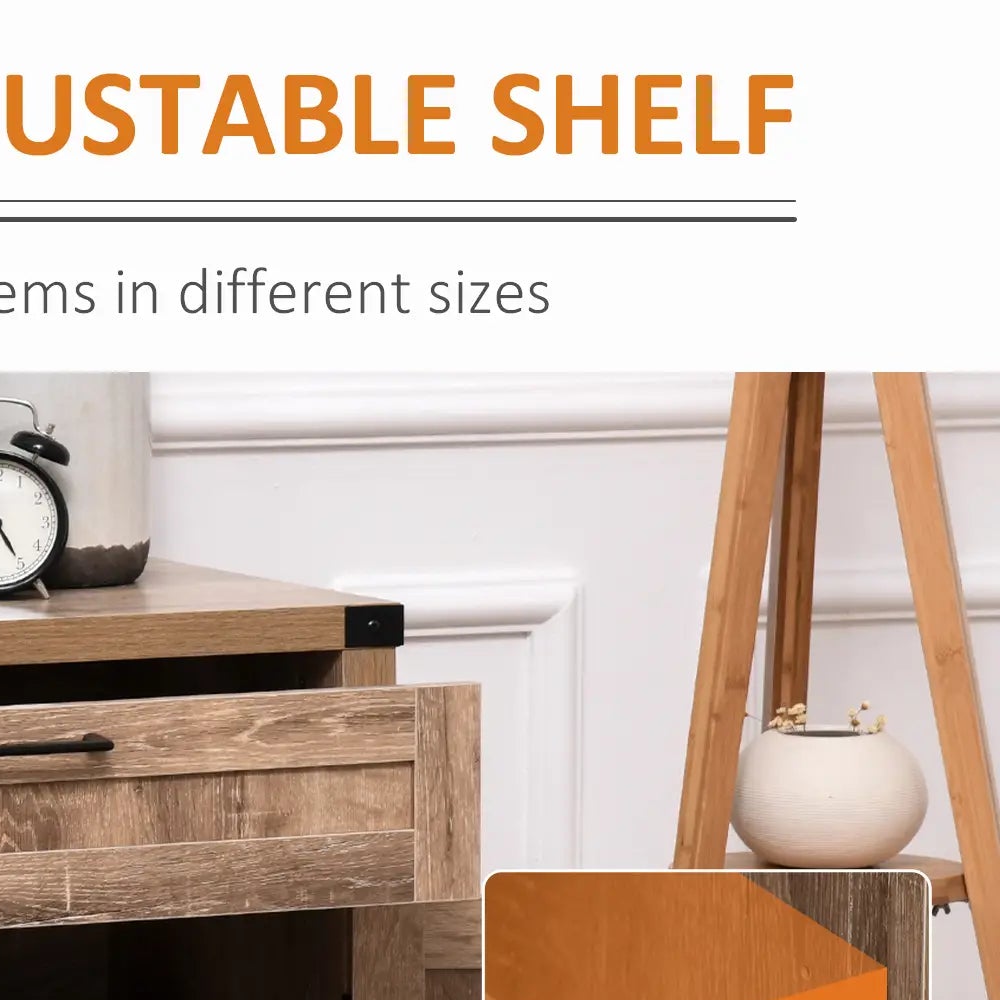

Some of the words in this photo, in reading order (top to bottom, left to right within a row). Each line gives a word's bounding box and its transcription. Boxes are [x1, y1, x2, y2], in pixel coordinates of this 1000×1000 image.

[17, 475, 23, 488] 1
[33, 491, 43, 506] 2
[40, 516, 50, 529] 3
[32, 538, 41, 552] 4
[15, 557, 25, 571] 5
